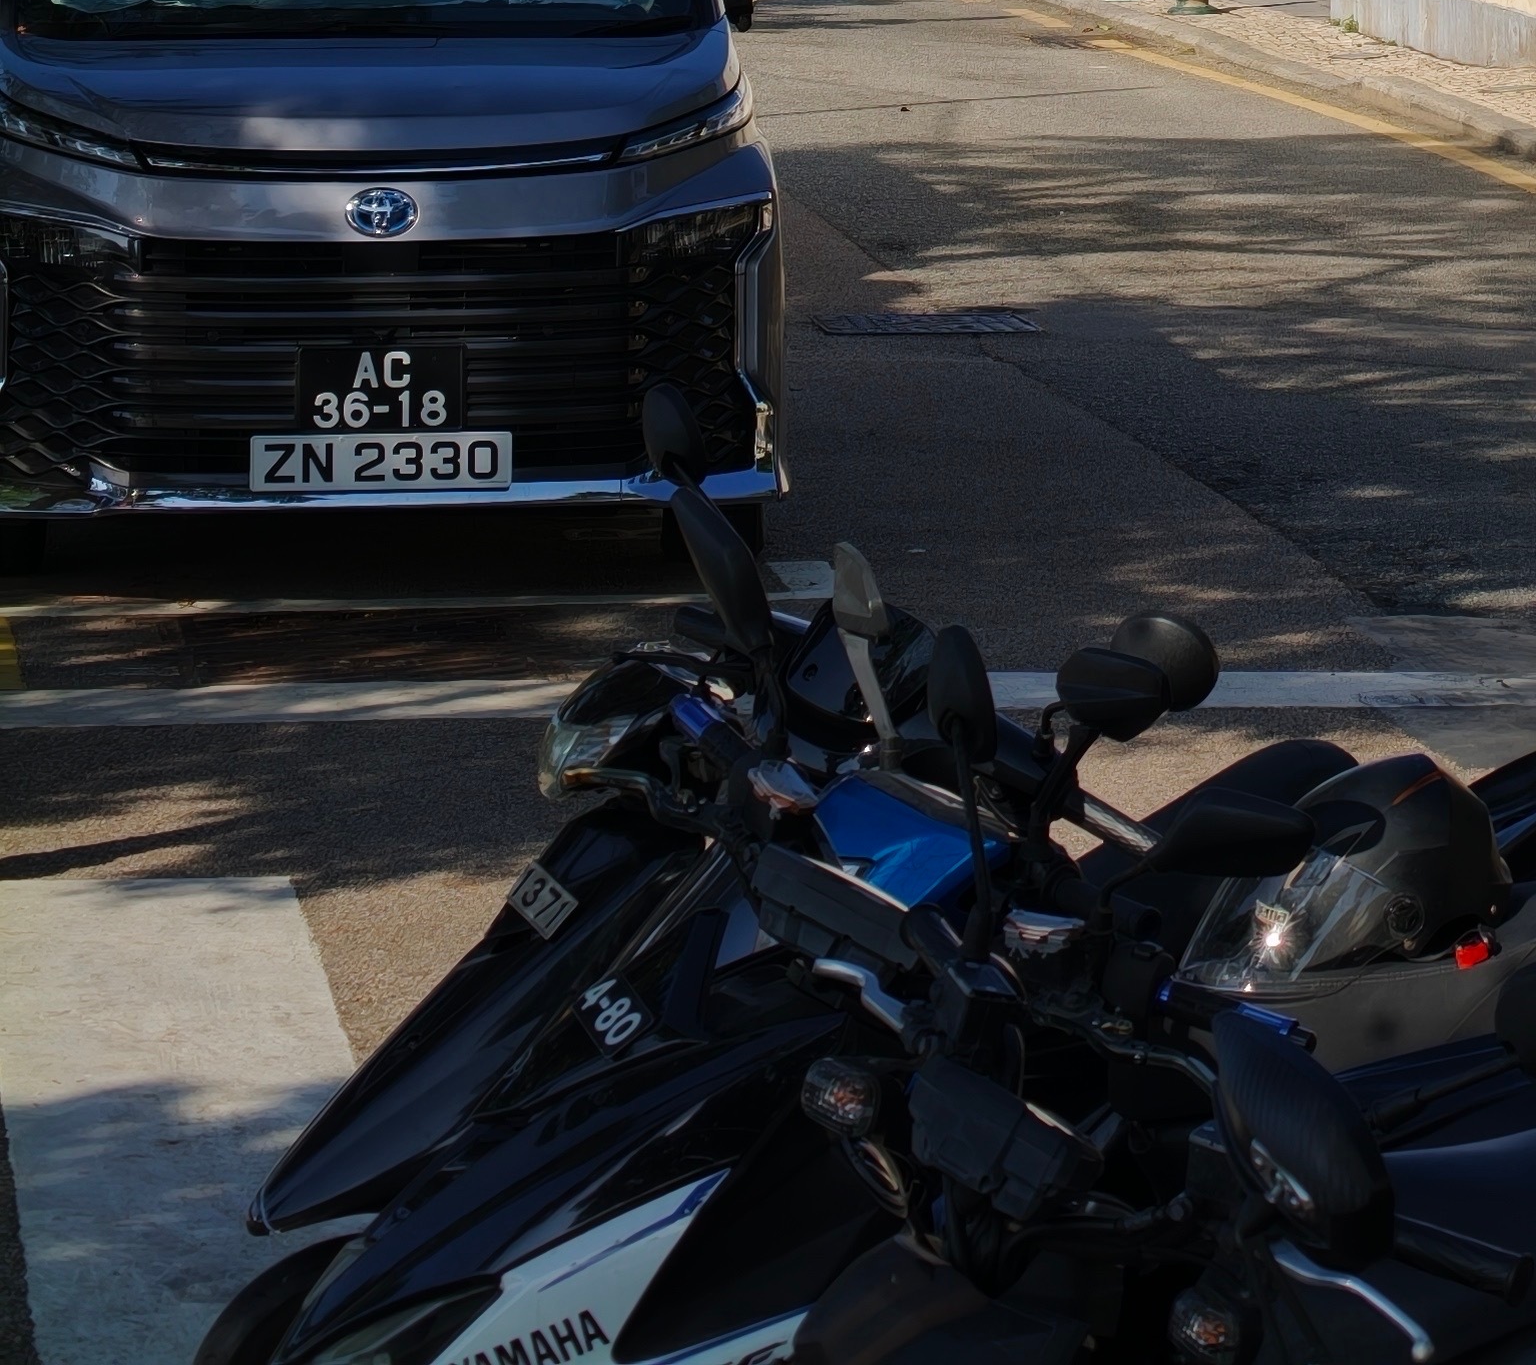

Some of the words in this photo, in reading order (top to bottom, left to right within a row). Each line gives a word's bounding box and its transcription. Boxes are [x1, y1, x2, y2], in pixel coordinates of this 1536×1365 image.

[352, 350, 411, 389] AC
[312, 389, 448, 429] 36-18
[263, 442, 335, 484] ZN
[353, 440, 499, 483] 2330
[511, 868, 570, 930] 1371
[580, 978, 643, 1046] 4-80
[449, 1310, 610, 1365] MAHA
